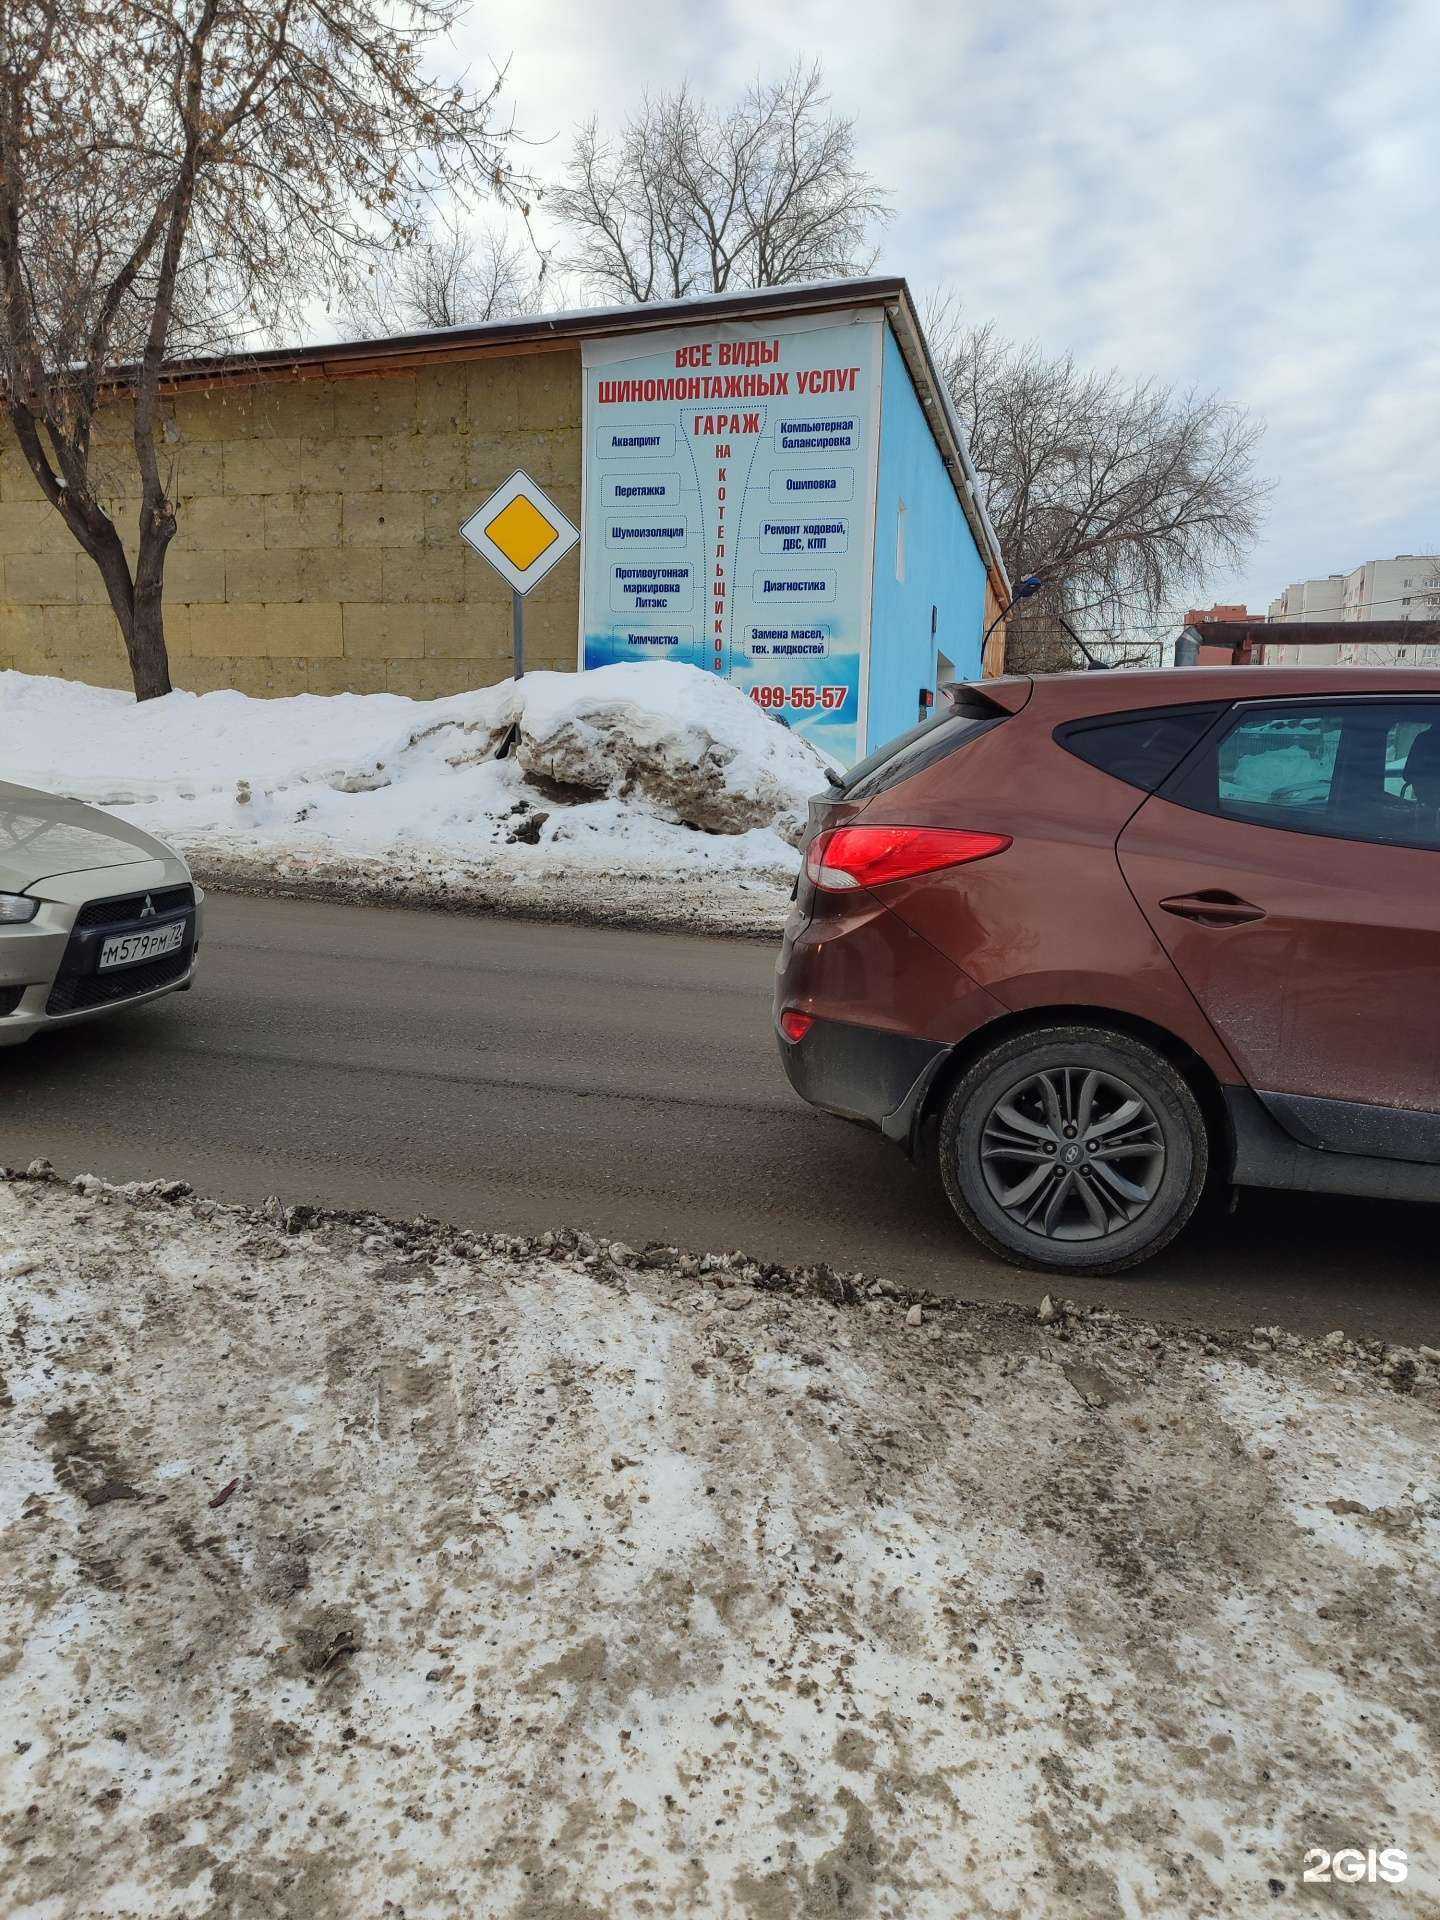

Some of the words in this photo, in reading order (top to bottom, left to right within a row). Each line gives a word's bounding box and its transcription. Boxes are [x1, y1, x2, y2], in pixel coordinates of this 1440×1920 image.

[675, 344, 712, 368] ВСЕ
[718, 340, 779, 368] ВИДЫ
[598, 374, 790, 404] ШИНОМОНТАЖНЫХ
[795, 368, 861, 394] УСЛУГ
[694, 413, 760, 436] ГАРАЖ
[780, 420, 854, 436] Компьютерная
[611, 435, 661, 448] Аквапринт
[782, 434, 851, 449] балансировка
[715, 445, 731, 458] НА
[786, 479, 836, 491] Ошиповка
[615, 486, 666, 498] Перетяжка
[612, 526, 684, 539] Шумоизоляция
[764, 524, 800, 536] Ремонт
[803, 523, 846, 536] ходовой,
[782, 539, 805, 551] ДВС,
[807, 538, 827, 549] КПП
[615, 567, 689, 580] Противоугонная
[623, 582, 681, 595] маркировка
[763, 579, 826, 593] Диагностика
[635, 597, 667, 608] Литэкс
[628, 634, 679, 646] Химчистка
[751, 628, 788, 640] Замена
[790, 627, 825, 641] масел,
[751, 644, 770, 655] тех.
[772, 641, 825, 655] жидкостей
[749, 686, 847, 709] 499-55-57
